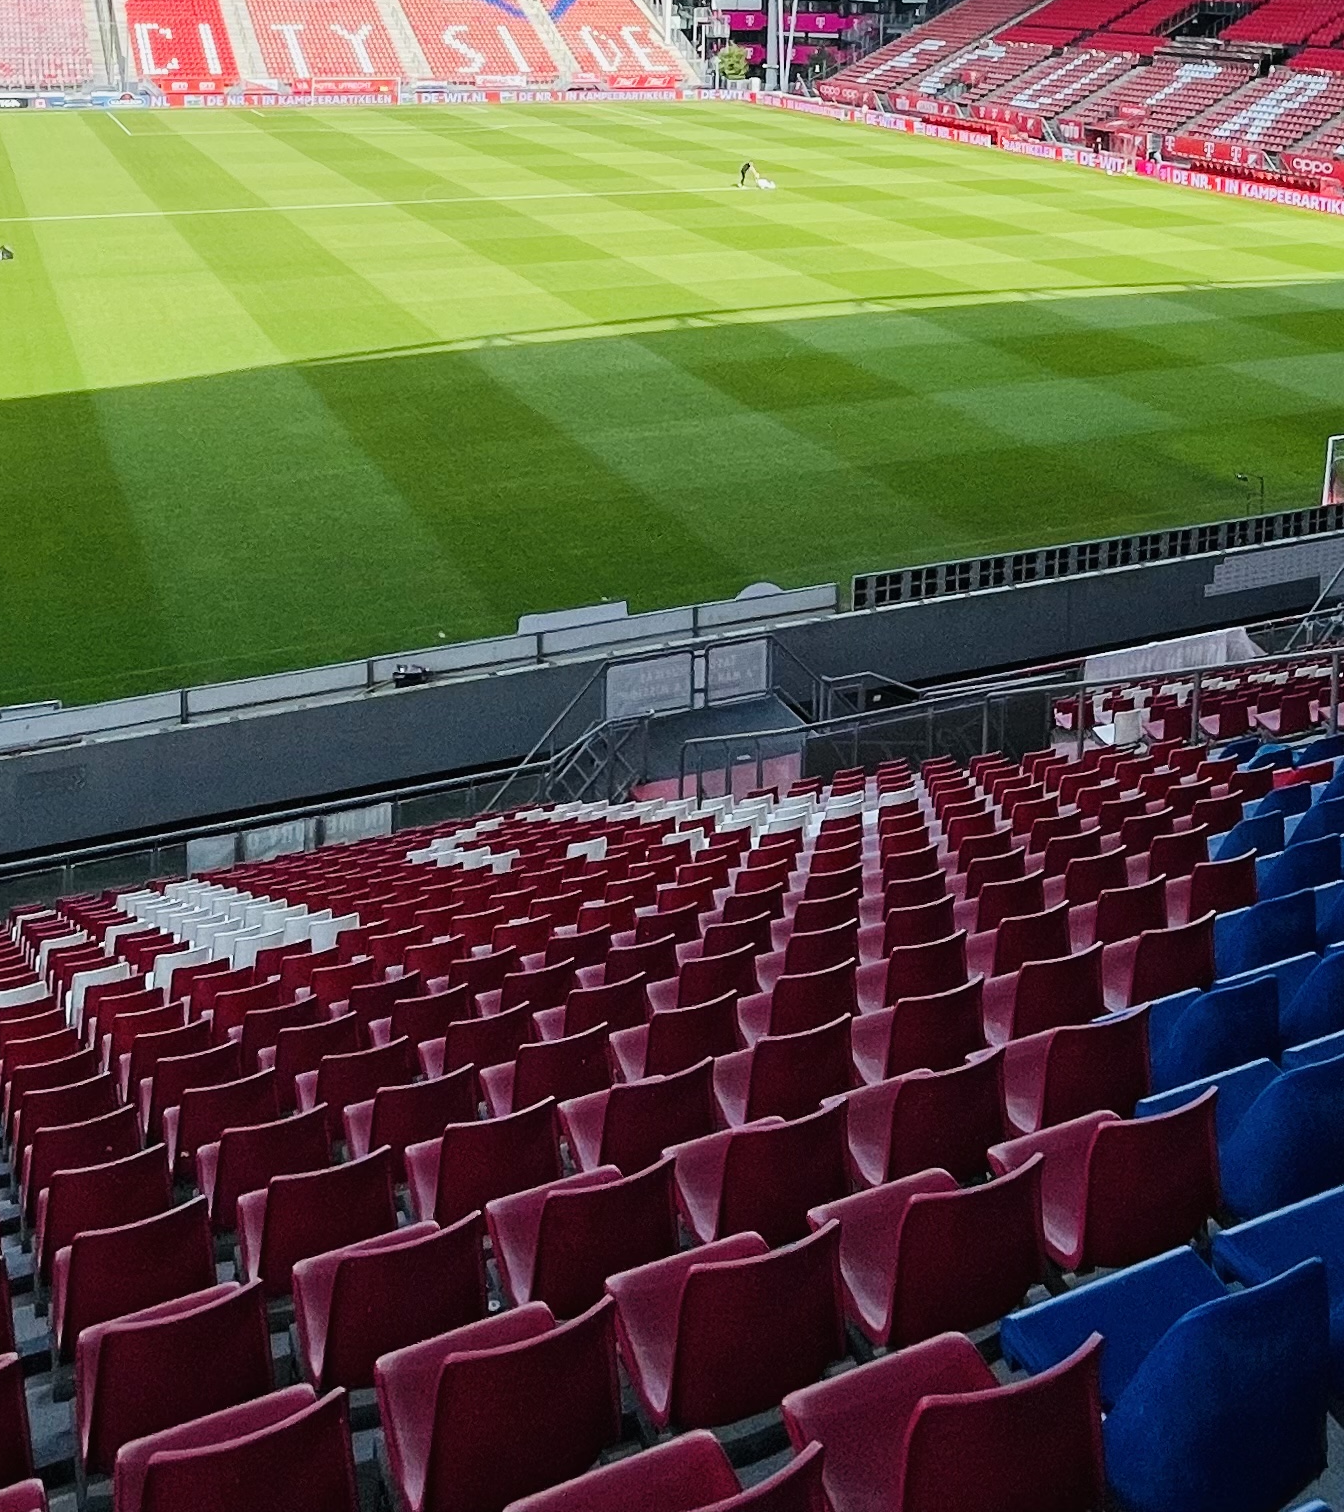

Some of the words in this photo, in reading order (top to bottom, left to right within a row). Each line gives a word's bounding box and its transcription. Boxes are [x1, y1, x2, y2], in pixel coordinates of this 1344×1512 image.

[206, 95, 223, 106] DE
[422, 92, 488, 103] DE-WIT.NL
[1292, 158, 1334, 174] oppo
[1172, 171, 1189, 186] DE
[1190, 174, 1212, 190] NR.
[1225, 179, 1238, 195] IN
